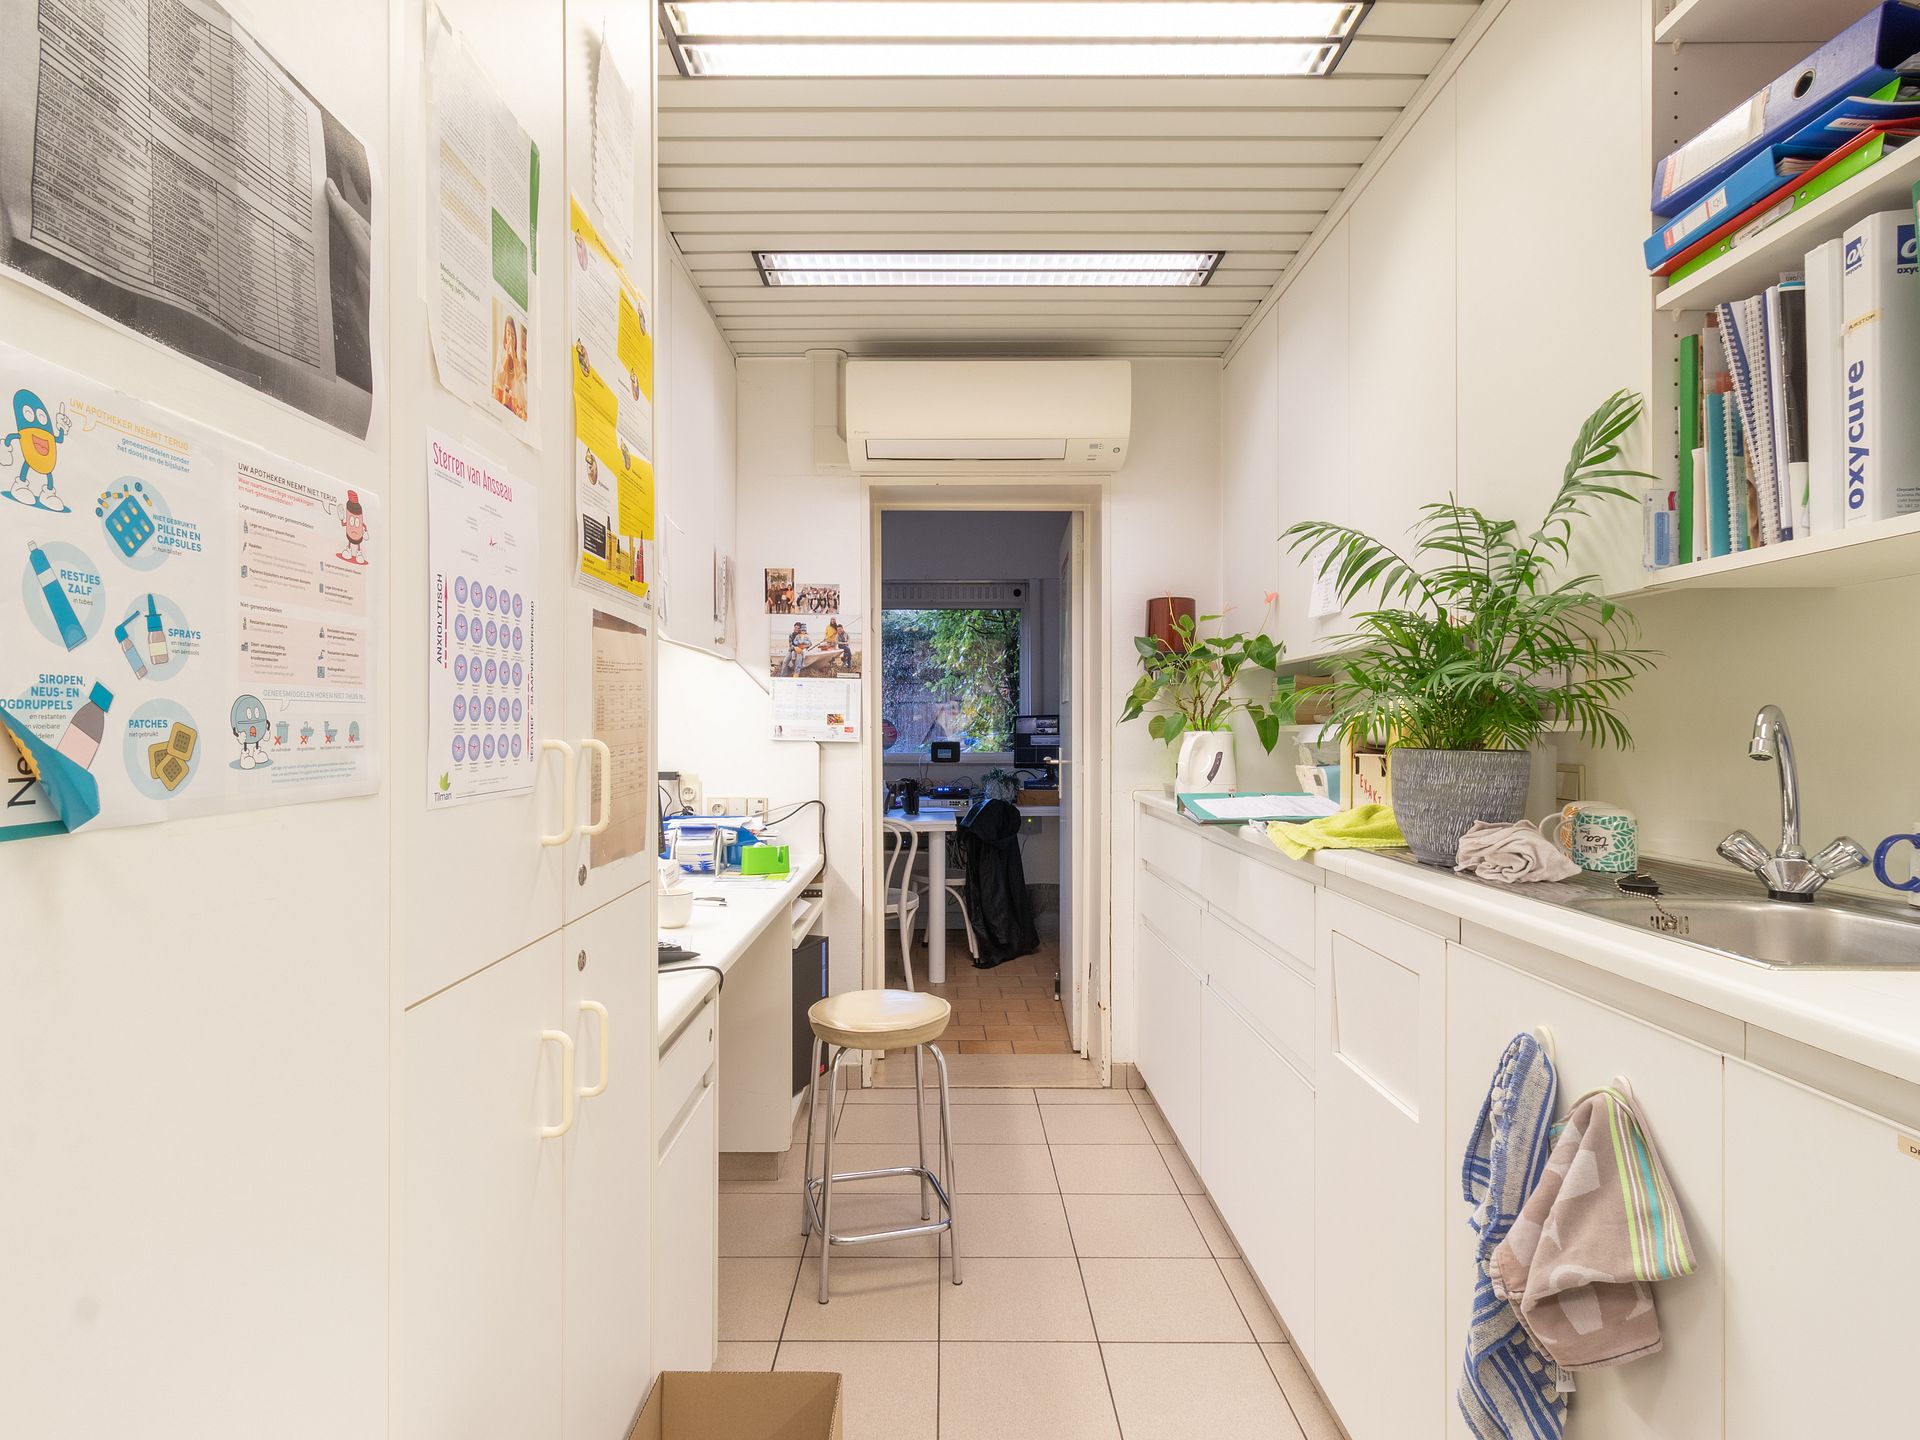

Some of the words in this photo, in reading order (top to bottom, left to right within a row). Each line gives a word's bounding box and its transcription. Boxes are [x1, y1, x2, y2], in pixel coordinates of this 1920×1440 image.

[69, 399, 84, 411] UW
[86, 406, 133, 429] APOTHEKER
[135, 425, 162, 441] NEEMT
[164, 435, 189, 451] TERUG
[1849, 360, 1869, 509] oxycure
[117, 444, 127, 455] het
[128, 447, 148, 461] doosje
[148, 455, 157, 463] en
[157, 456, 165, 466] de
[165, 459, 190, 473] bijsluiter
[121, 438, 170, 459] geneesmiddelen
[170, 453, 190, 466] zonder
[433, 442, 465, 479] Sterren
[467, 464, 481, 487] van
[483, 469, 513, 502] Ansseau
[238, 462, 249, 472] UW
[250, 467, 286, 485] APOTHEKER
[286, 479, 306, 493] NEEMT
[306, 486, 320, 496] NIET
[320, 490, 338, 503] TERUG
[152, 514, 167, 523] NIET
[166, 517, 197, 530] GEBRUIKTE
[157, 523, 189, 539] PILLEN
[189, 531, 201, 541] EN
[157, 534, 202, 552] CAPSULES
[60, 569, 101, 586] RESTJES
[68, 583, 92, 596] ZALF
[78, 598, 94, 606] tubes
[168, 628, 201, 640] SPRAYS
[39, 673, 86, 687] SIROPEN,
[31, 686, 64, 698] NEUS-
[66, 687, 80, 698] EN
[263, 689, 314, 699] GENEESMIDDELEN
[33, 722, 60, 730] vloeibare
[128, 719, 168, 729] PATCHES
[138, 731, 159, 739] gebruikt
[434, 790, 453, 802] Tilman
[1583, 835, 1609, 849] tea
